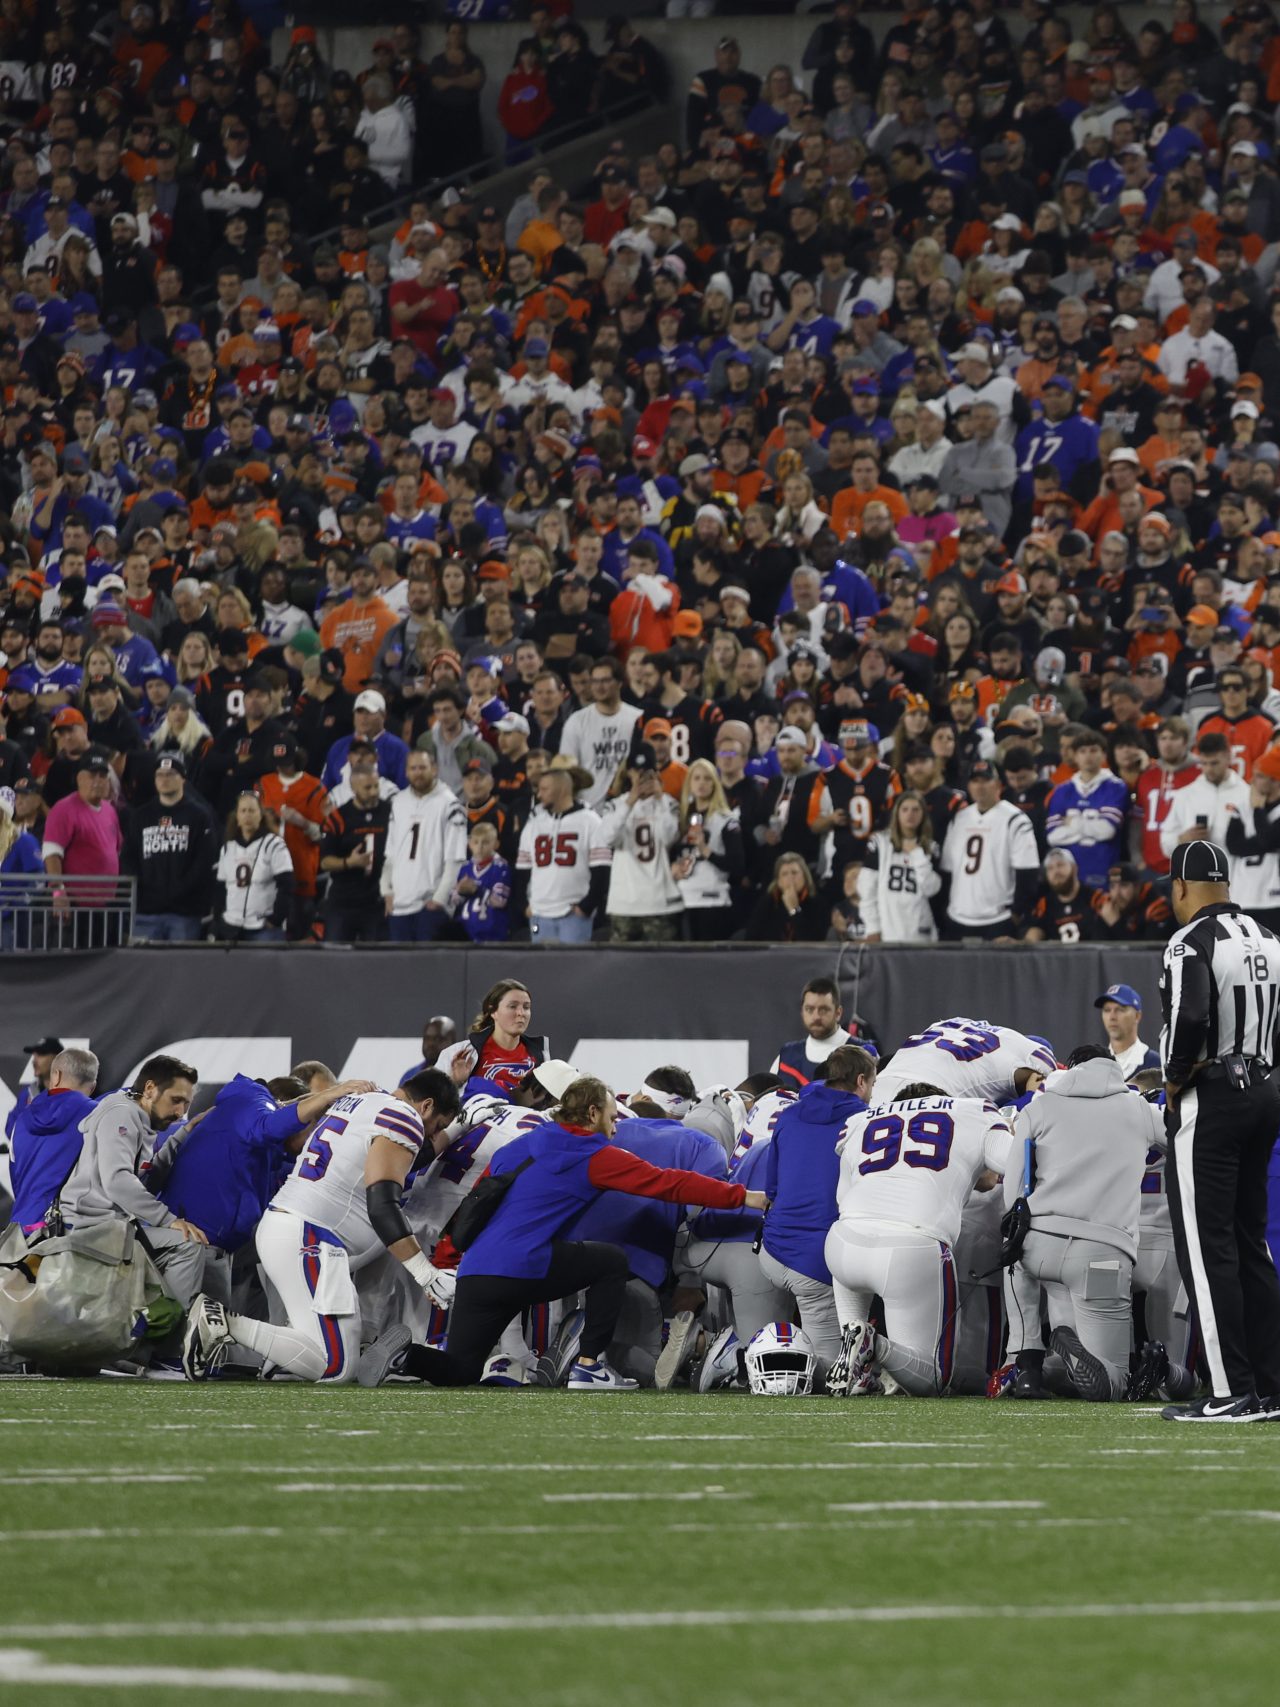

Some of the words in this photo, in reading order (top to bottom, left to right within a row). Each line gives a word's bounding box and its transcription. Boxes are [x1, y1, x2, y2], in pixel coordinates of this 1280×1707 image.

[51, 62, 77, 90] 83
[101, 368, 136, 400] 17
[1020, 436, 1064, 472] 17
[261, 620, 288, 639] 17
[226, 689, 246, 728] 9
[671, 724, 690, 764] 8
[849, 795, 873, 840] 9
[143, 839, 188, 853] NORTH
[409, 823, 421, 860] 1
[535, 833, 578, 867] 85
[635, 825, 655, 862] 9
[965, 834, 984, 876] 9
[889, 864, 917, 893] 85
[1167, 944, 1186, 960] 18
[1244, 955, 1269, 982] 18
[866, 1098, 929, 1119] SETTLE
[932, 1099, 954, 1110] JR
[859, 1111, 955, 1177] 99
